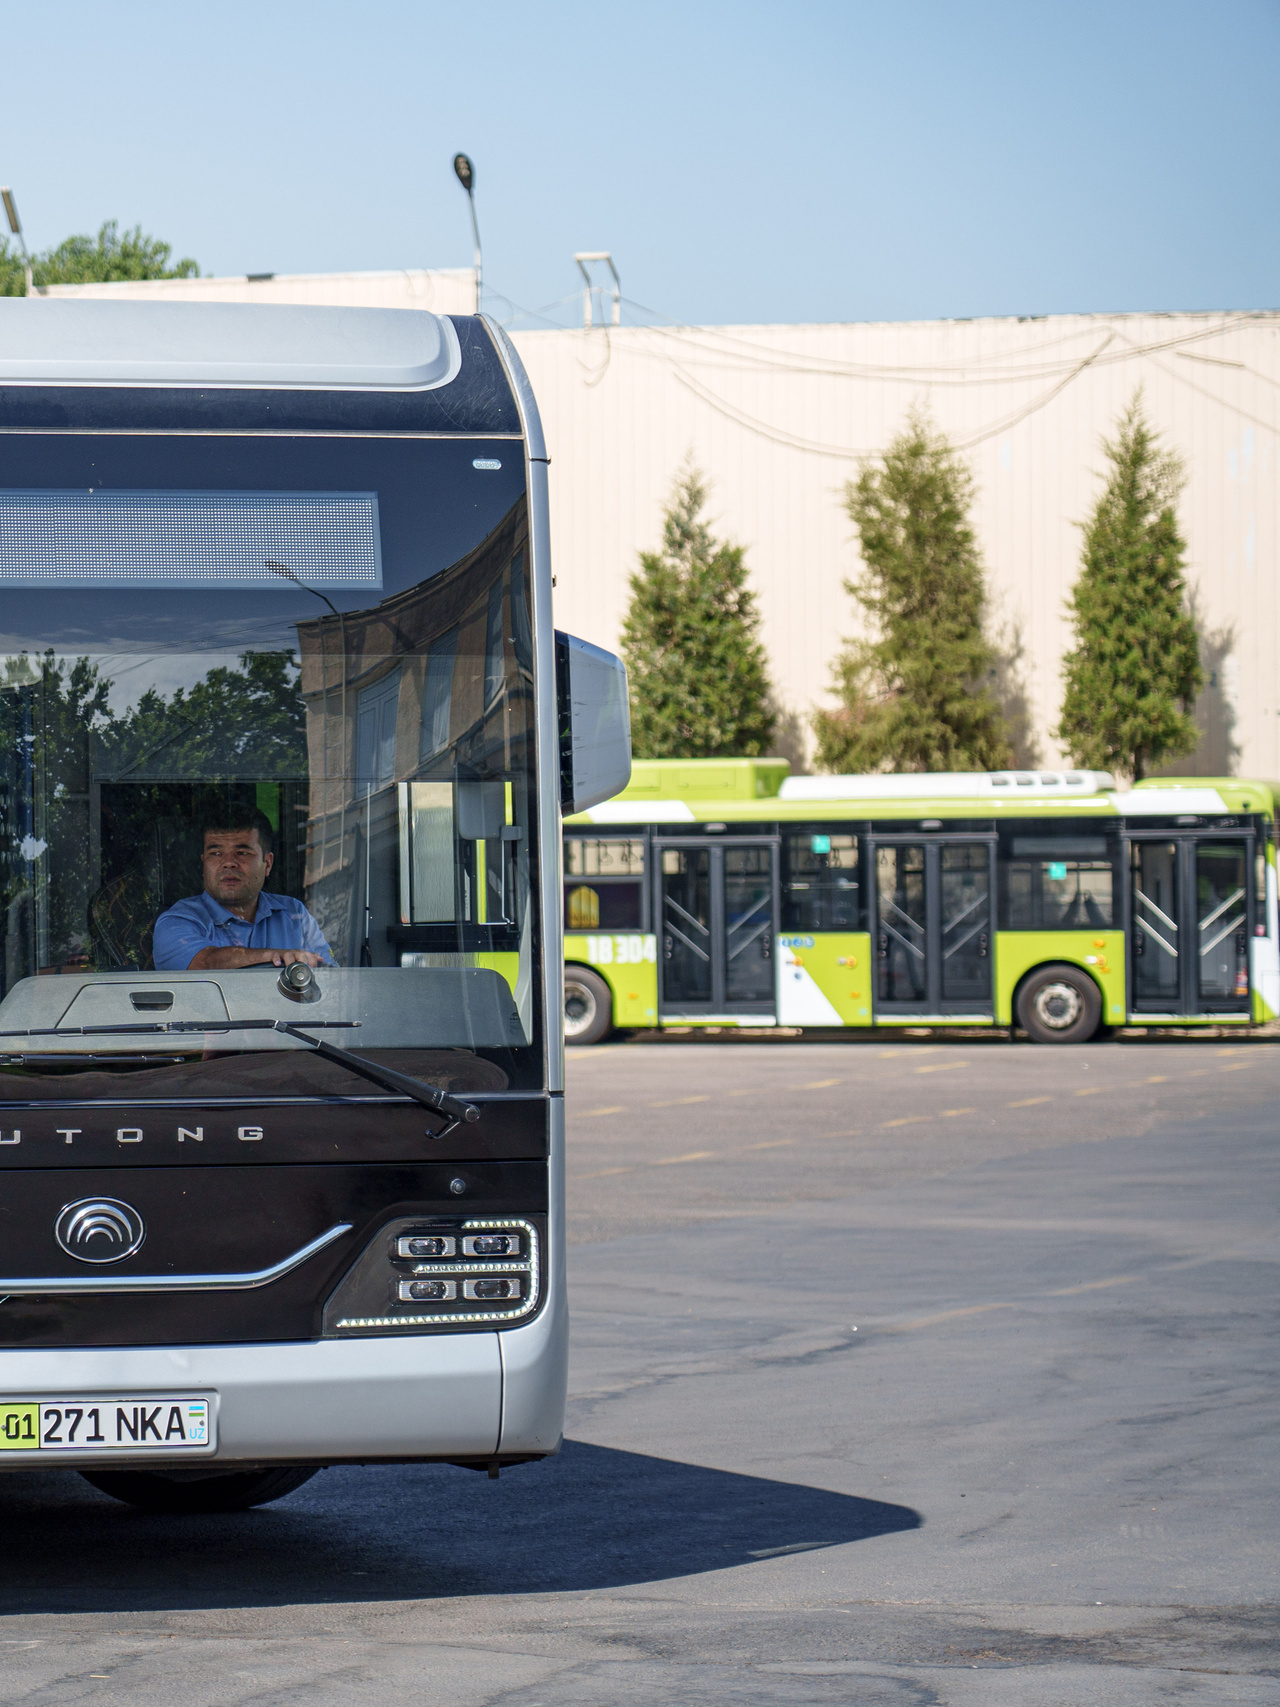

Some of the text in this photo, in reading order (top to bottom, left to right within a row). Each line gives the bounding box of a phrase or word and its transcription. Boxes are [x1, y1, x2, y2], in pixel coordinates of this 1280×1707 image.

[5, 1406, 205, 1443] 01 271 NKA UZ
